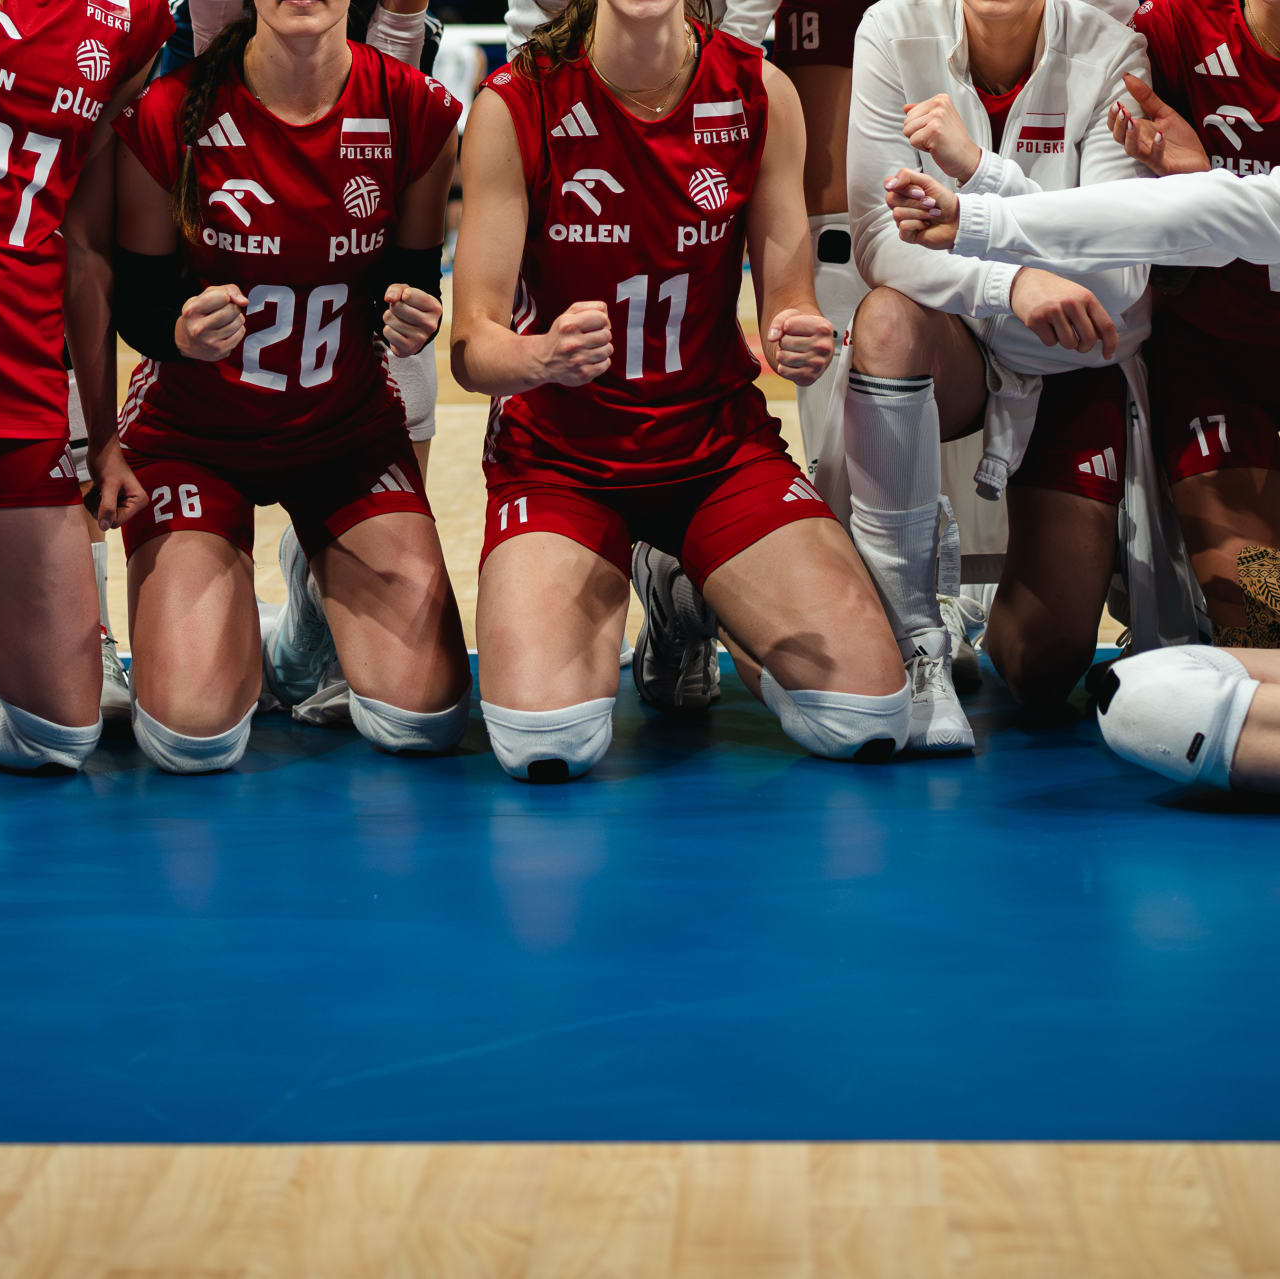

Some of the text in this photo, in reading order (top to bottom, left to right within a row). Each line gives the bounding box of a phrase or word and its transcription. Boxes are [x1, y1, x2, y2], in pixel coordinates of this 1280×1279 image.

[86, 6, 131, 33] POLSKA
[788, 11, 820, 51] 19
[50, 86, 104, 122] plus
[340, 147, 392, 160] POLSKA
[693, 127, 750, 145] POLSKA
[1211, 155, 1271, 177] RLEN
[202, 227, 281, 255] ORLEN
[328, 227, 384, 262] plus
[548, 224, 630, 244] ORLEN
[677, 215, 735, 252] plu
[239, 283, 349, 392] 26
[616, 272, 690, 380] 11
[1189, 414, 1231, 457] 17
[150, 483, 203, 524] 26
[497, 496, 529, 532] 11
